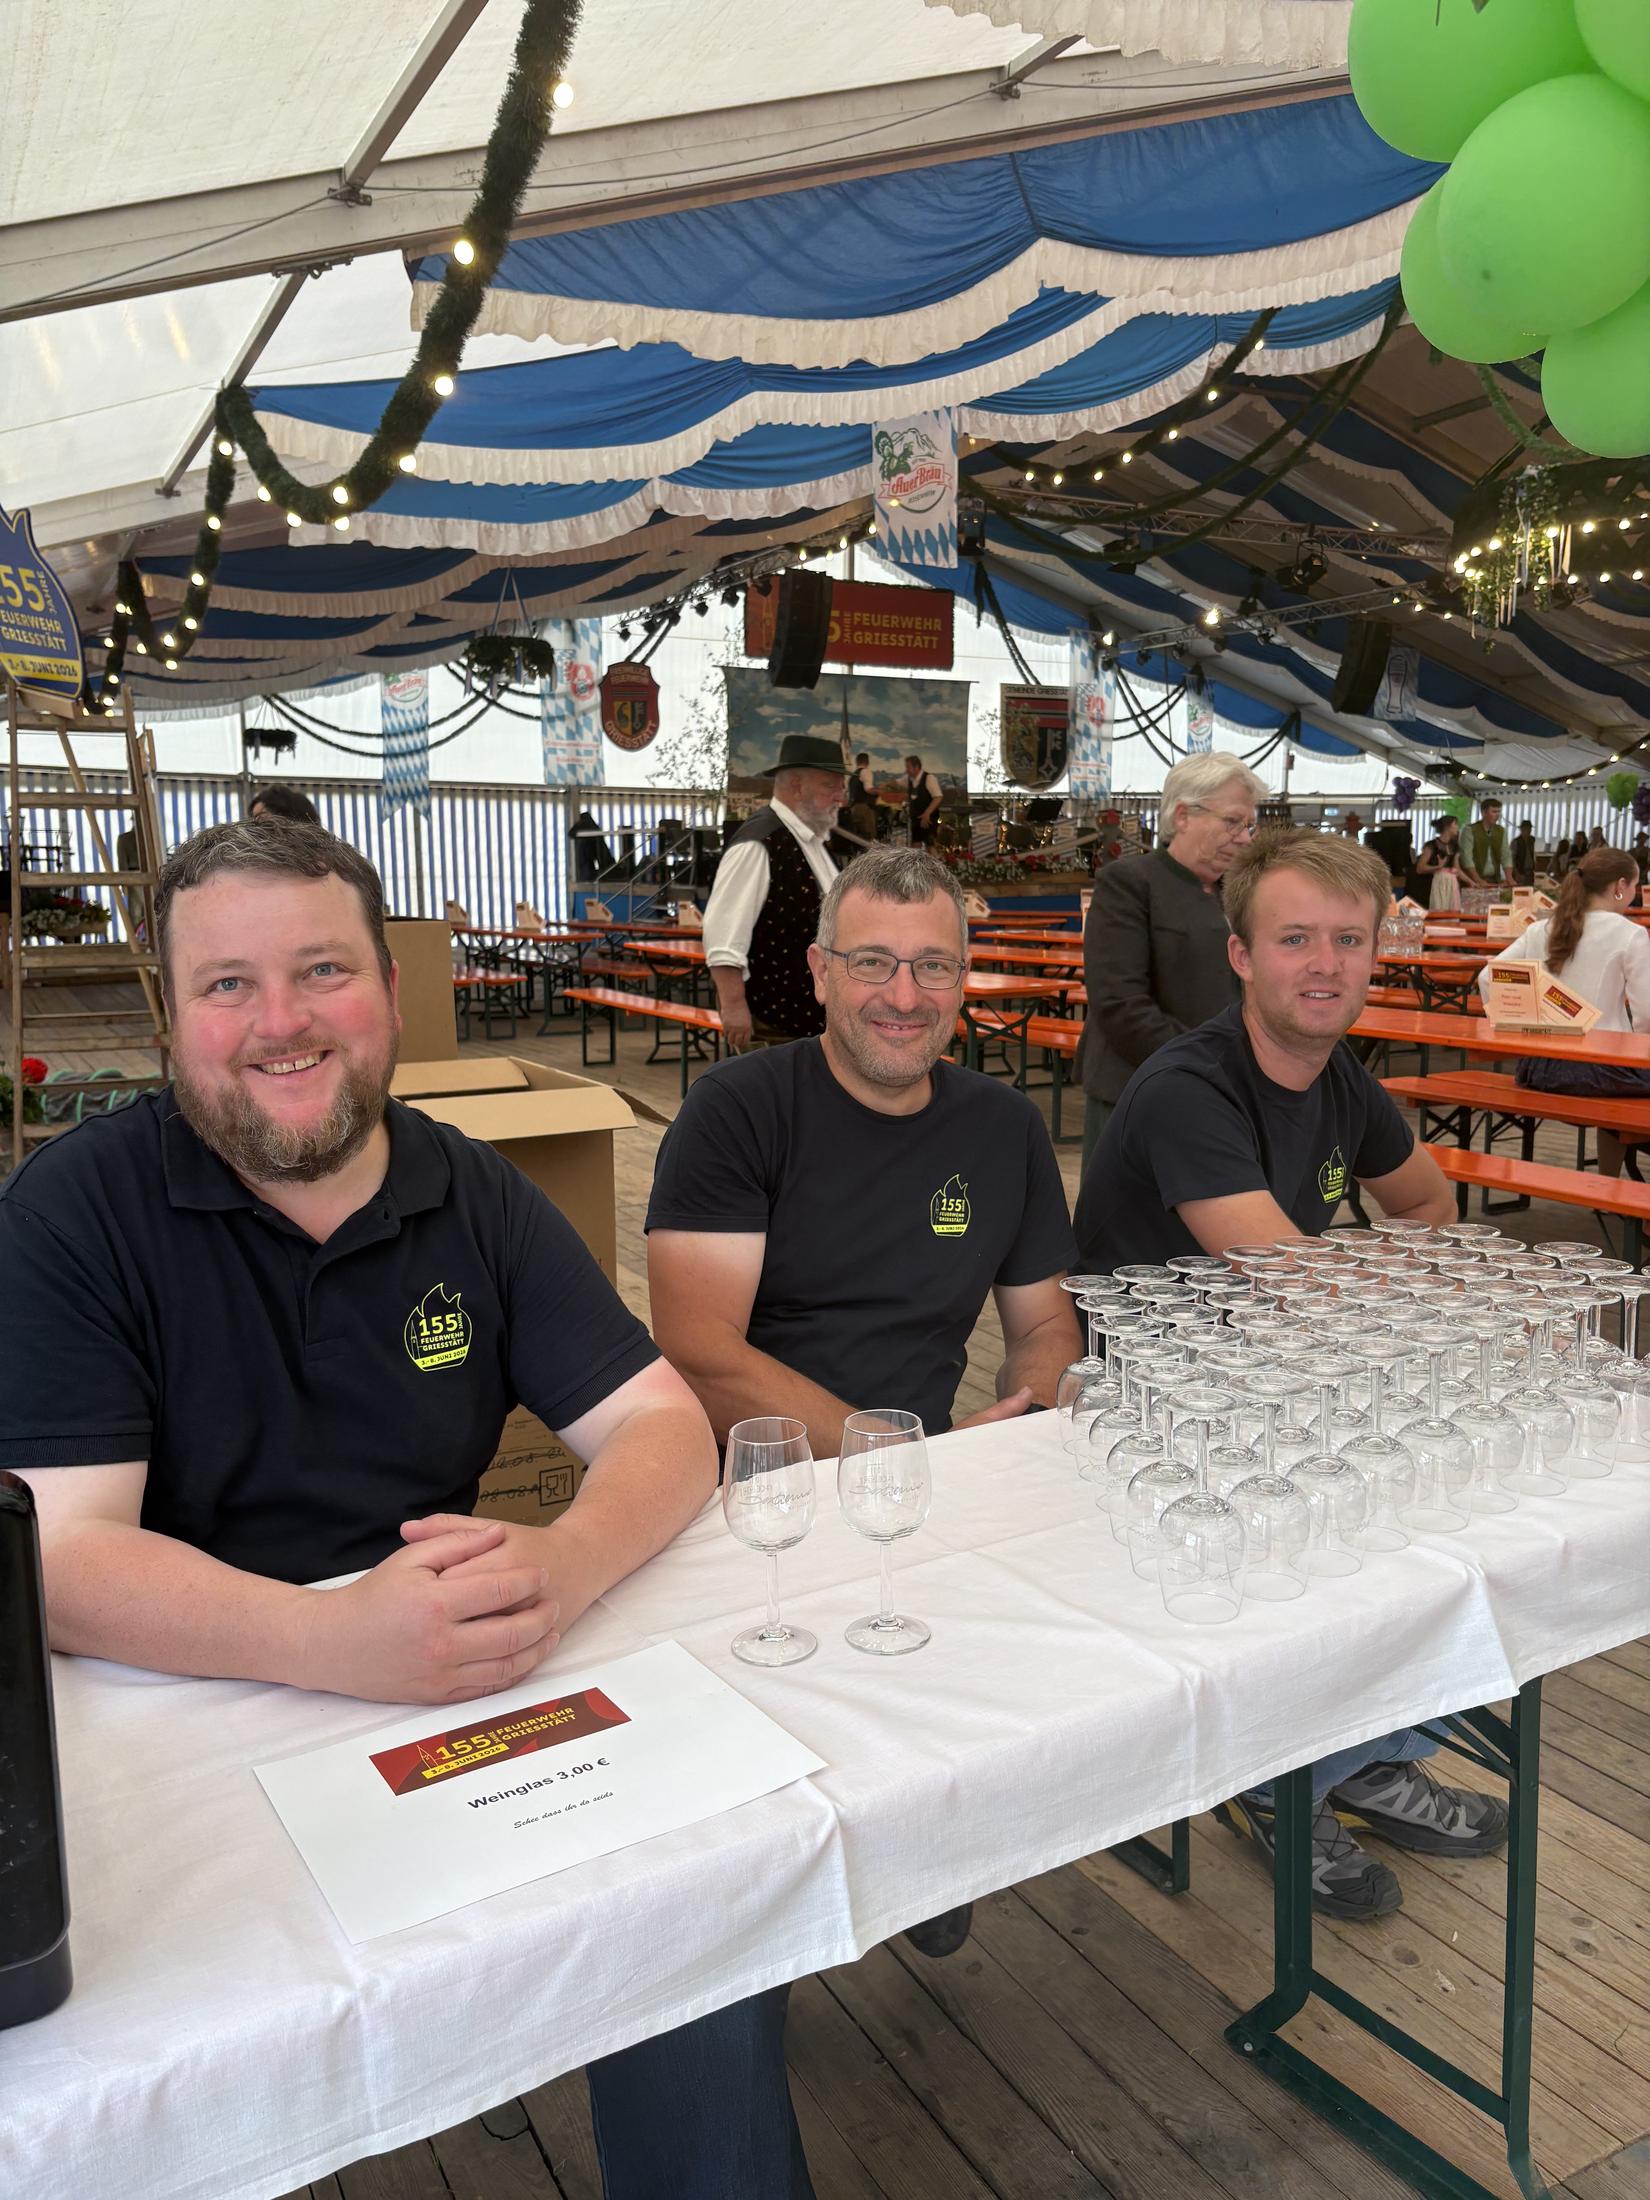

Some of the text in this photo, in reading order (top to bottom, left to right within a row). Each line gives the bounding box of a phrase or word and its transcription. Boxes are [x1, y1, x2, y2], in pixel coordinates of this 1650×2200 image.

[0, 564, 45, 612] 55
[0, 609, 64, 634] EUERWEHR
[853, 611, 942, 631] FEUERWEHR
[1, 625, 67, 652] GRIESSTÄTT
[853, 631, 939, 649] GRIESSTÄTT
[1327, 1167, 1343, 1180] 155
[940, 1198, 962, 1212] 155
[418, 1313, 458, 1336] 155
[420, 1331, 465, 1345] FEUERWEHR
[422, 1338, 465, 1352] GRIESSTÄTT
[437, 1353, 452, 1362] JUNI
[497, 1707, 575, 1735] FEUERWEHR
[502, 1714, 576, 1741] GRIESSTÄTT
[435, 1734, 491, 1760] 155
[455, 1754, 478, 1766] JUNI
[479, 1746, 501, 1758] 2026
[467, 1757, 611, 1809] Weinglas 3,00 €
[513, 1816, 540, 1829] Schee
[542, 1809, 562, 1819] dass
[565, 1803, 578, 1812] ihr
